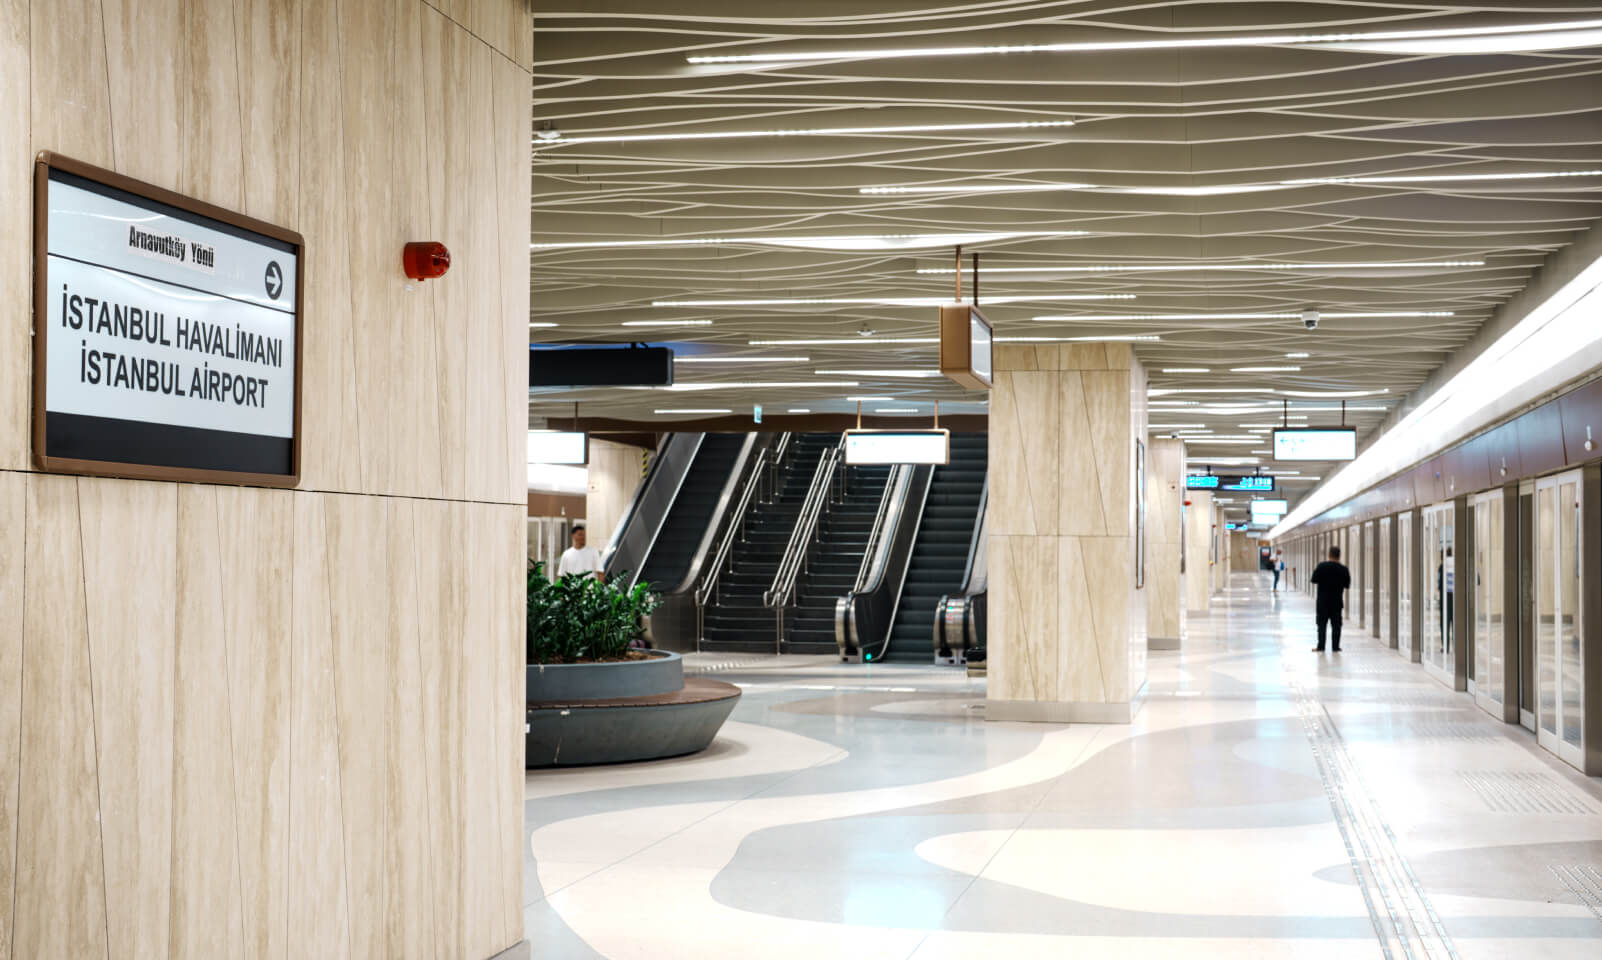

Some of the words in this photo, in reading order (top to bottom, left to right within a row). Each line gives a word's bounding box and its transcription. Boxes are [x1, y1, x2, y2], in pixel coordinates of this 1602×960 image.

[129, 225, 186, 262] Arnavutköy
[191, 242, 214, 268] Yönü
[61, 284, 171, 347] İSTANBUL
[176, 316, 283, 368] HAVALİMANI
[80, 340, 186, 397] İSTANBUL
[189, 361, 269, 408] AİRPORT
